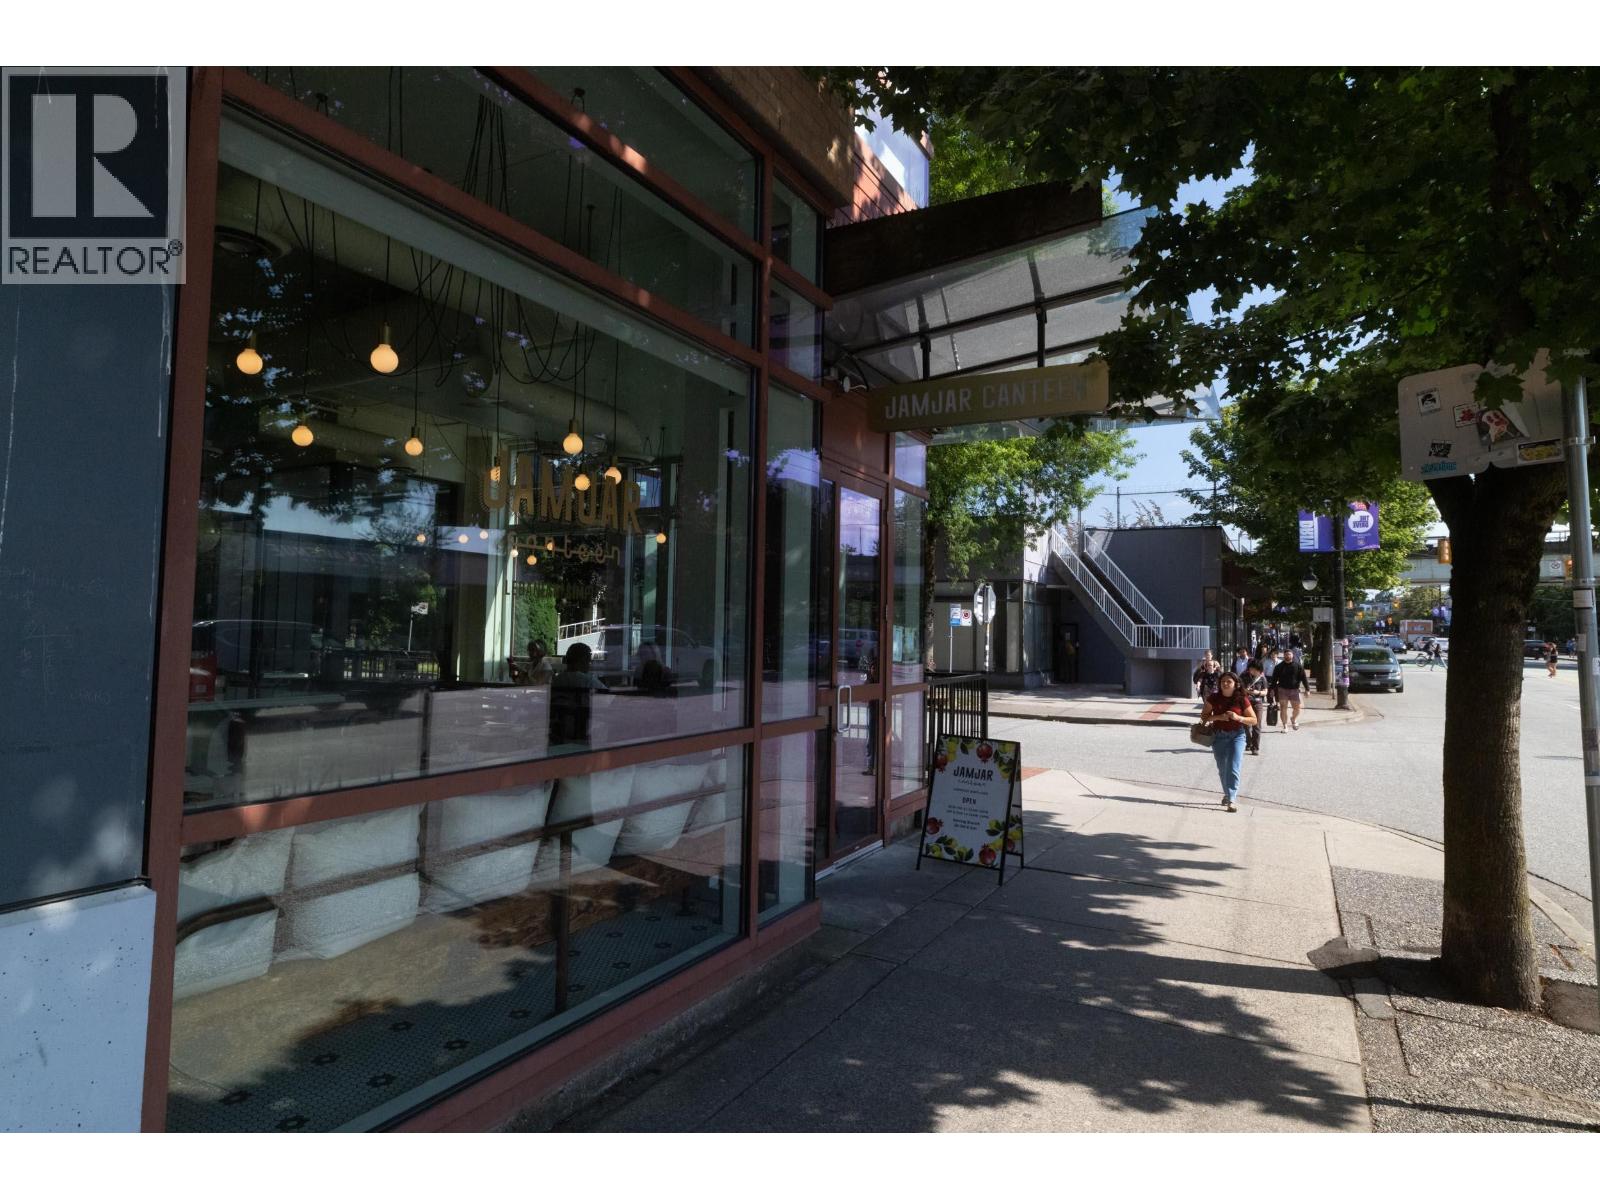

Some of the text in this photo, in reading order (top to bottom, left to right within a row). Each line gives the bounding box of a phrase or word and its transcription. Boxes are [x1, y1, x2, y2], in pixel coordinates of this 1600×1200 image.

[884, 375, 1088, 420] JAMJAR CANTEEN
[482, 449, 643, 535] JAMJAR
[953, 766, 994, 782] JAMJAR
